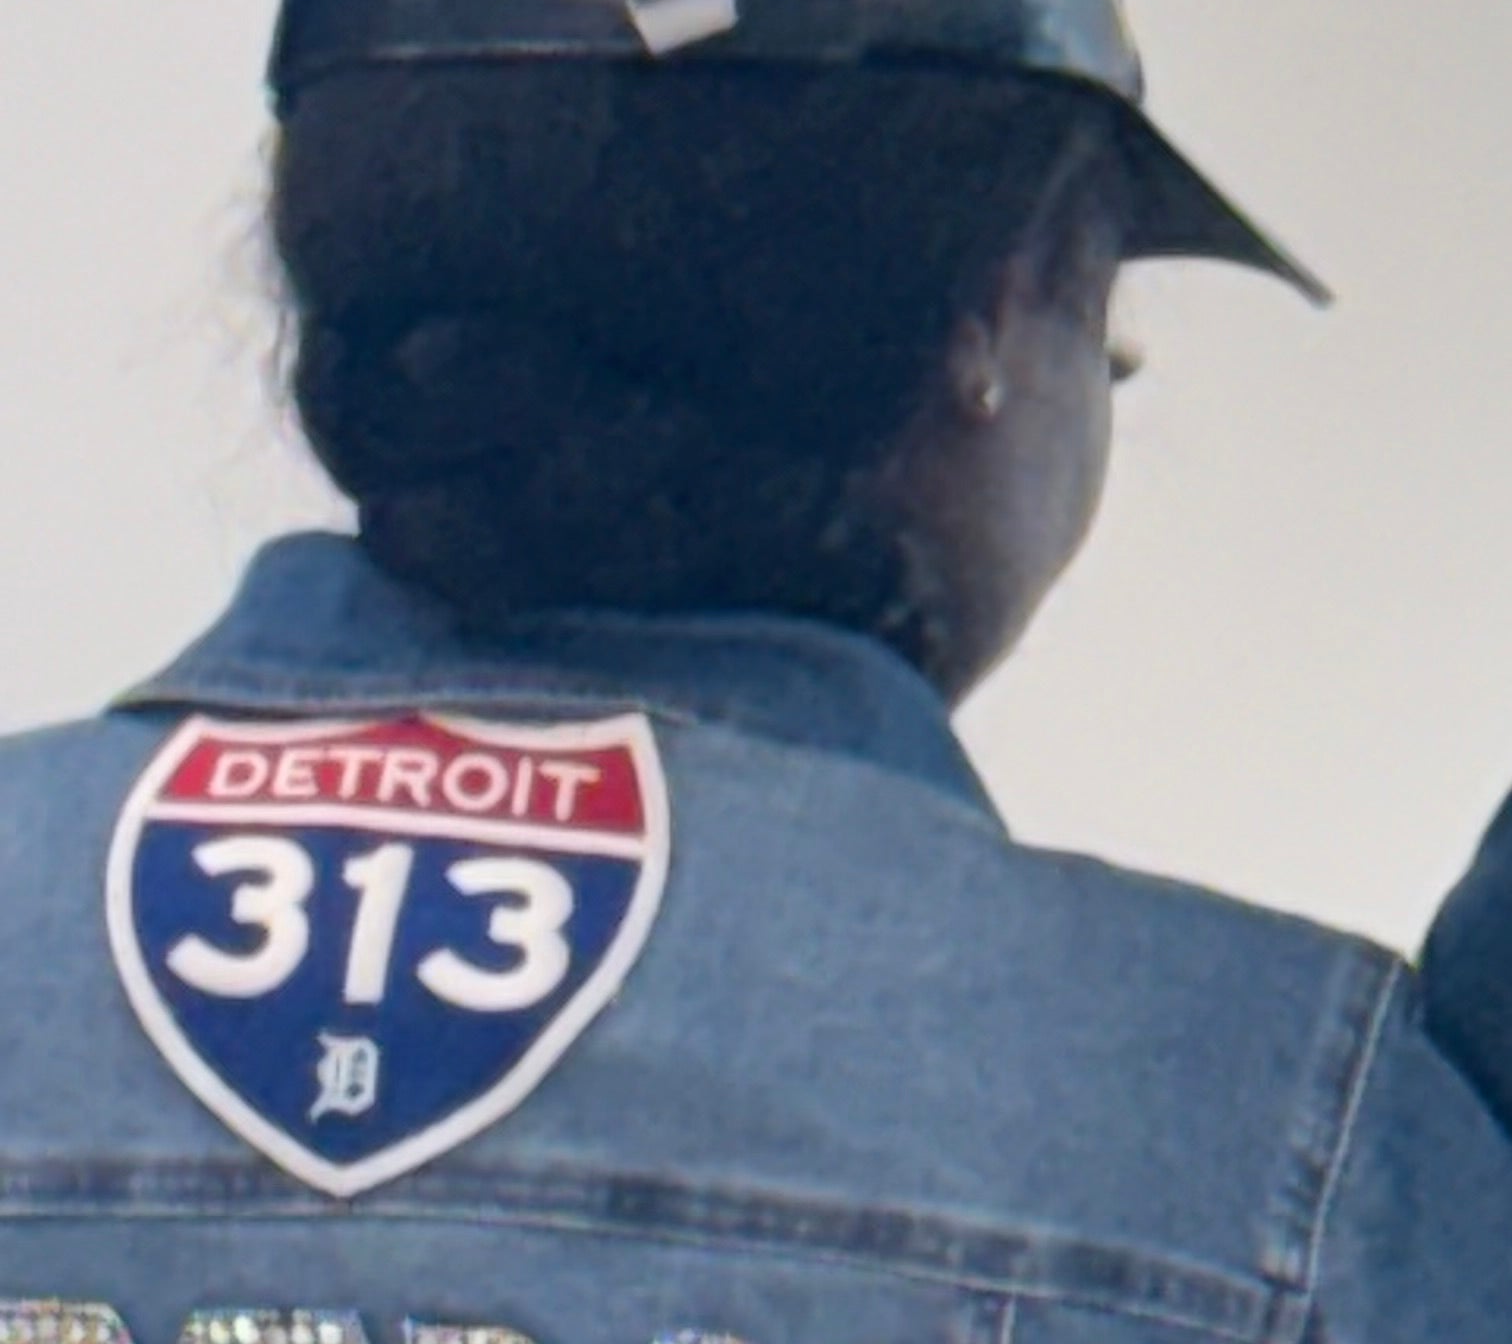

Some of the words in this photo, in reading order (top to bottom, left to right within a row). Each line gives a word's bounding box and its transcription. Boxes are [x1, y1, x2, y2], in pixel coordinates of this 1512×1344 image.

[207, 747, 602, 822] DETROIT
[166, 836, 575, 1013] 313
[310, 1031, 380, 1123] D
